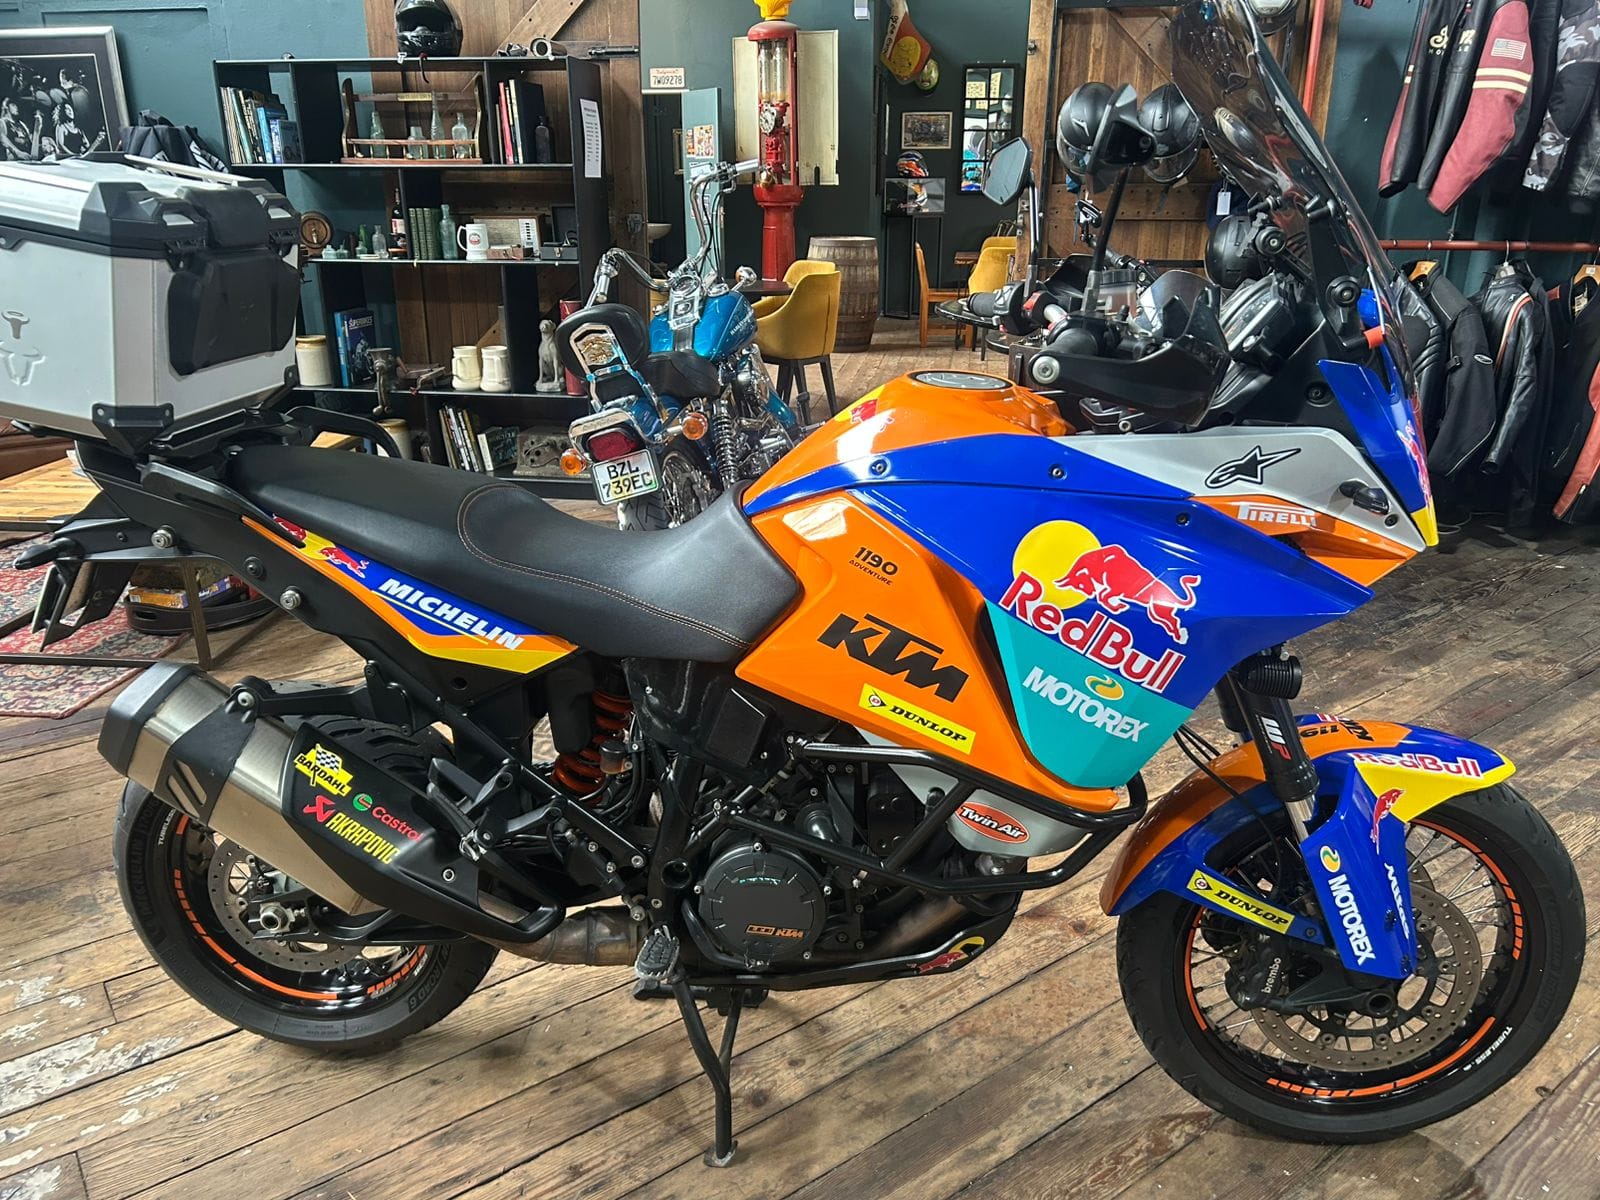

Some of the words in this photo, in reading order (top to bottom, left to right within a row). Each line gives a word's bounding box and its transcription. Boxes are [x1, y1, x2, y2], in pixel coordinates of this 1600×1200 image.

[602, 472, 653, 498] 739EC
[607, 460, 640, 480] BZL
[1231, 501, 1317, 527] PIRELLI
[849, 559, 894, 586] ADVENTURE
[855, 547, 898, 576] 1190
[378, 578, 525, 651] MICHELIN
[817, 613, 970, 704] KTM
[1022, 666, 1150, 743] MOTOREX
[889, 705, 968, 743] DUNLOP
[297, 755, 348, 794] BARDAHL
[371, 806, 425, 843] Castrol
[961, 806, 998, 829] Twin
[997, 824, 1025, 838] Air
[1214, 889, 1289, 926] DUNLOP
[1327, 873, 1377, 967] MOTOREX
[1261, 957, 1282, 994] brembo
